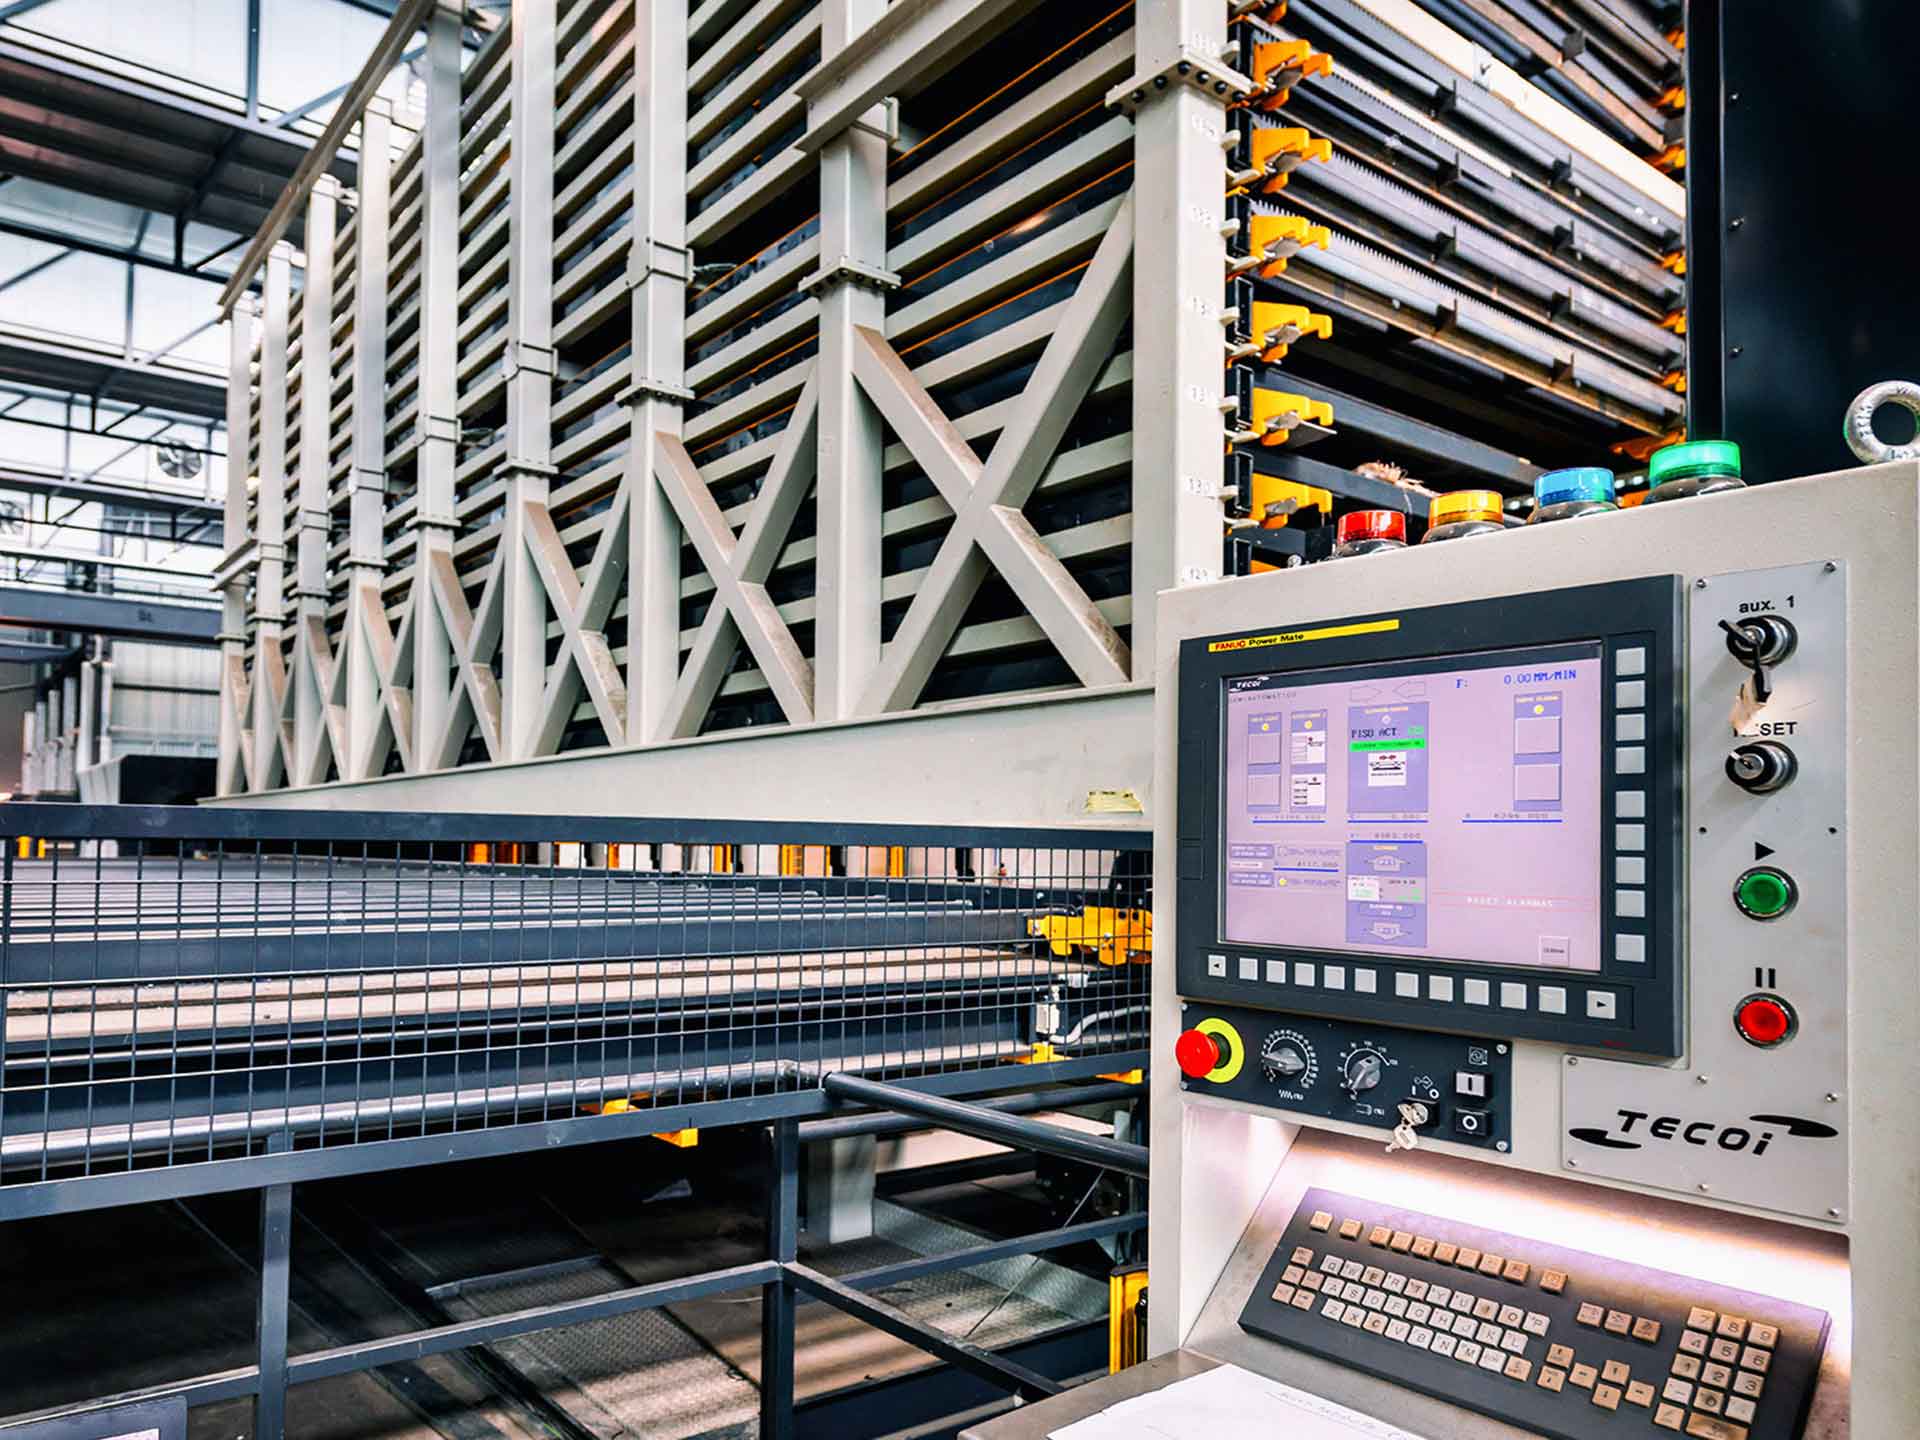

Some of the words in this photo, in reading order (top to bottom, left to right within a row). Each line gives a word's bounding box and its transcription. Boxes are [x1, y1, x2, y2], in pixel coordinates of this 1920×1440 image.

[1739, 600, 1775, 613] aux.
[1786, 595, 1794, 608] 1
[1215, 640, 1246, 650] FANUC
[1249, 637, 1277, 646] Power
[1280, 633, 1304, 643] Mate
[1504, 673, 1532, 685] 0.00
[1533, 669, 1577, 682] MM/MIN
[1328, 1262, 1336, 1271] Q
[1369, 1274, 1376, 1282] E
[1391, 1279, 1399, 1287] R
[1415, 1285, 1422, 1293] T
[1507, 1312, 1518, 1321] O
[1330, 1284, 1338, 1292] A
[1349, 1289, 1358, 1298] S
[1415, 1308, 1424, 1317] G
[1439, 1315, 1448, 1324] H
[1486, 1330, 1494, 1339] K
[1512, 1339, 1520, 1348] L
[1699, 1315, 1709, 1325] 7
[1727, 1322, 1738, 1333] 8
[1760, 1331, 1770, 1342] 9
[1328, 1306, 1336, 1315] Z
[1350, 1312, 1359, 1321] X
[1371, 1318, 1380, 1328] C
[1394, 1326, 1402, 1335] V
[1440, 1340, 1450, 1350] N
[1465, 1348, 1475, 1356] M
[1690, 1338, 1702, 1348] 4
[1721, 1345, 1732, 1356] 5
[1753, 1355, 1764, 1366] 6
[1684, 1363, 1691, 1373] 1
[1713, 1371, 1725, 1382] 2
[1745, 1380, 1756, 1391] 3
[1706, 1395, 1717, 1406] 0
